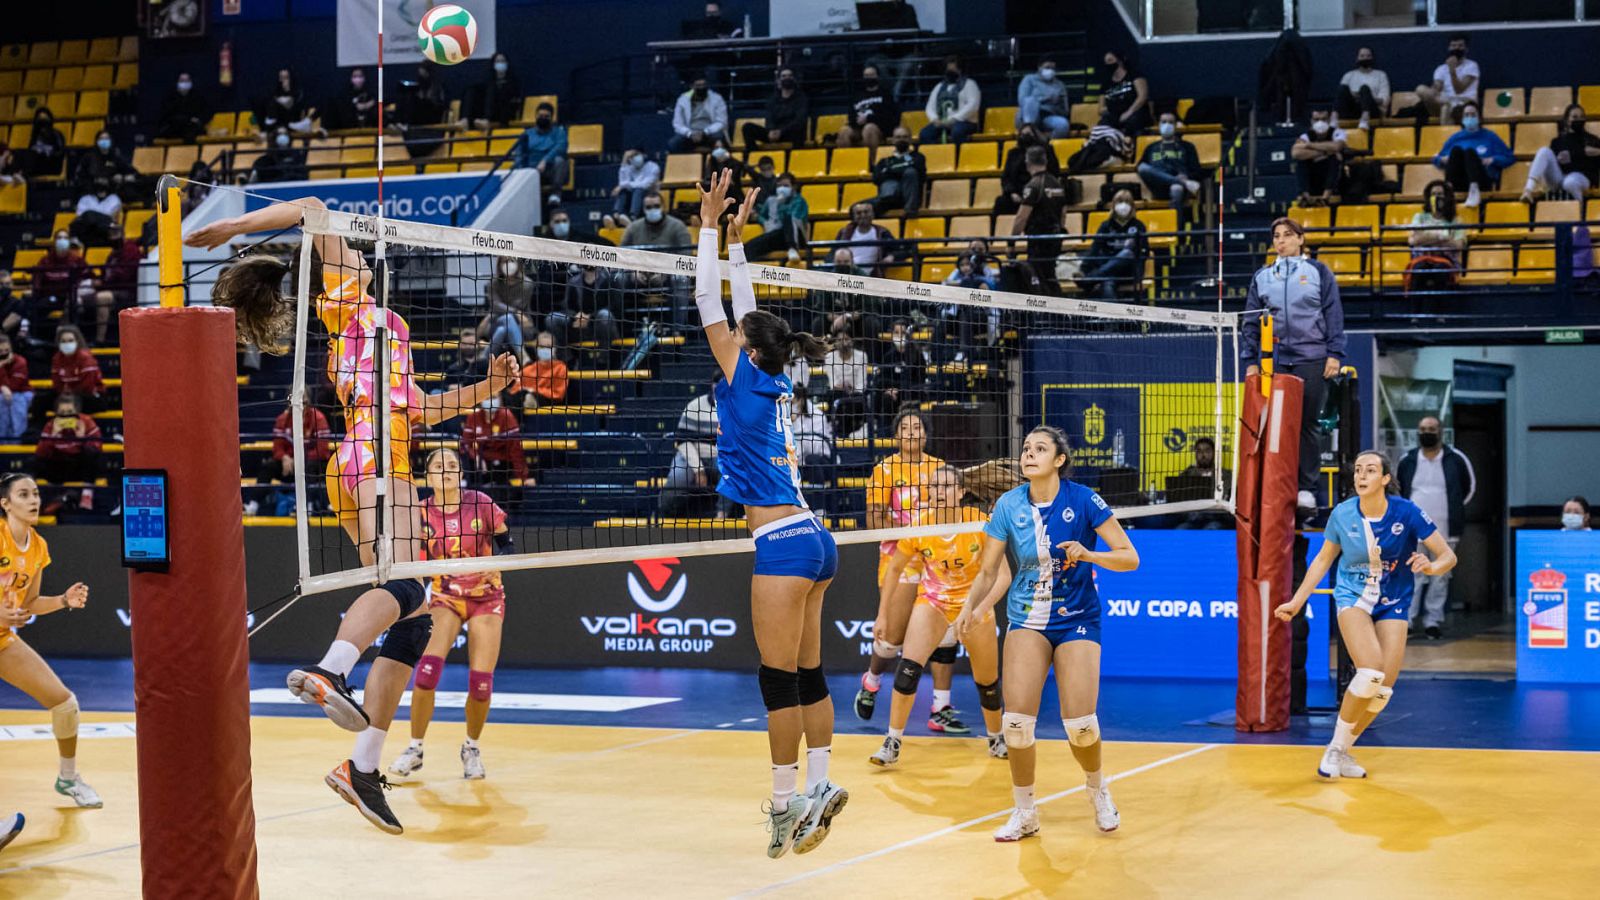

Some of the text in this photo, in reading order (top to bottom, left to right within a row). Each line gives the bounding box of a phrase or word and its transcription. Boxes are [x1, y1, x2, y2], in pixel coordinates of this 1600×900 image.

[350, 216, 398, 237] rfevb.om
[472, 232, 514, 251] rfevb.com
[580, 246, 617, 263] rfevb.com
[761, 267, 791, 282] rfevb.com
[837, 278, 865, 290] rfevb.com
[906, 284, 932, 297] rfevb.com
[969, 291, 992, 303] rfevb.com
[450, 536, 460, 552] 2
[941, 558, 965, 569] 15
[10, 572, 29, 589] 13
[1107, 599, 1239, 618] XIV COPA PR
[580, 612, 737, 637] volkano
[1076, 625, 1087, 635] 4
[604, 637, 714, 653] MEDIA GROUP
